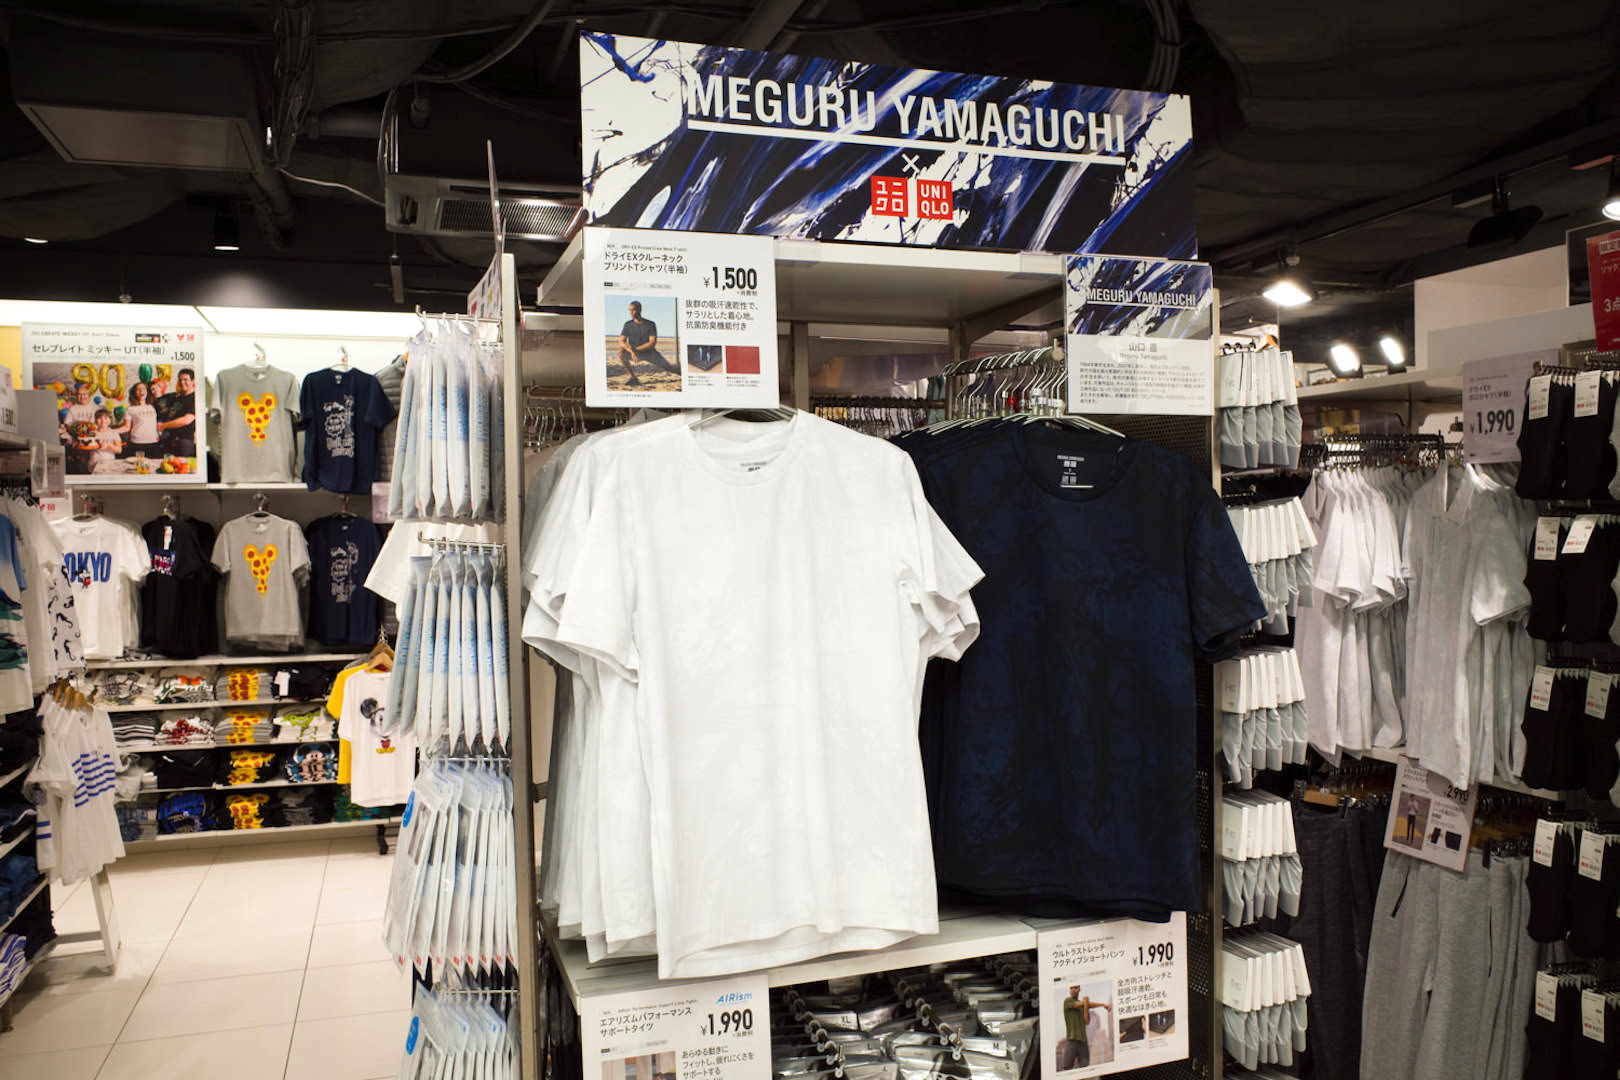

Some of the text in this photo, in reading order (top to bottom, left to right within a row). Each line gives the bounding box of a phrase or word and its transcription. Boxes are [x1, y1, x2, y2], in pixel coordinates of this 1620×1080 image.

[685, 72, 1126, 153] MEGURU YAMAGUCHI
[604, 251, 684, 263] ドライEXクルーネック
[603, 262, 688, 274] プリントTシャツ(半袖)
[703, 266, 758, 291] ¥1,500
[1087, 287, 1197, 306] MEGURU YAMAGUCHI
[32, 344, 83, 354] セレブレイト
[88, 344, 121, 354] ミッキー
[63, 551, 112, 583] OKYO
[1052, 944, 1106, 959] ウルトラストレッチ
[1052, 950, 1126, 968] アクティブショートパンツ
[716, 992, 753, 1003] AIRism
[600, 1007, 692, 1027] エアリズムパフォーマンス
[701, 1008, 753, 1036] ¥1,990
[600, 1023, 654, 1037] サポートタイツ
[683, 1066, 721, 1079] サポートする
